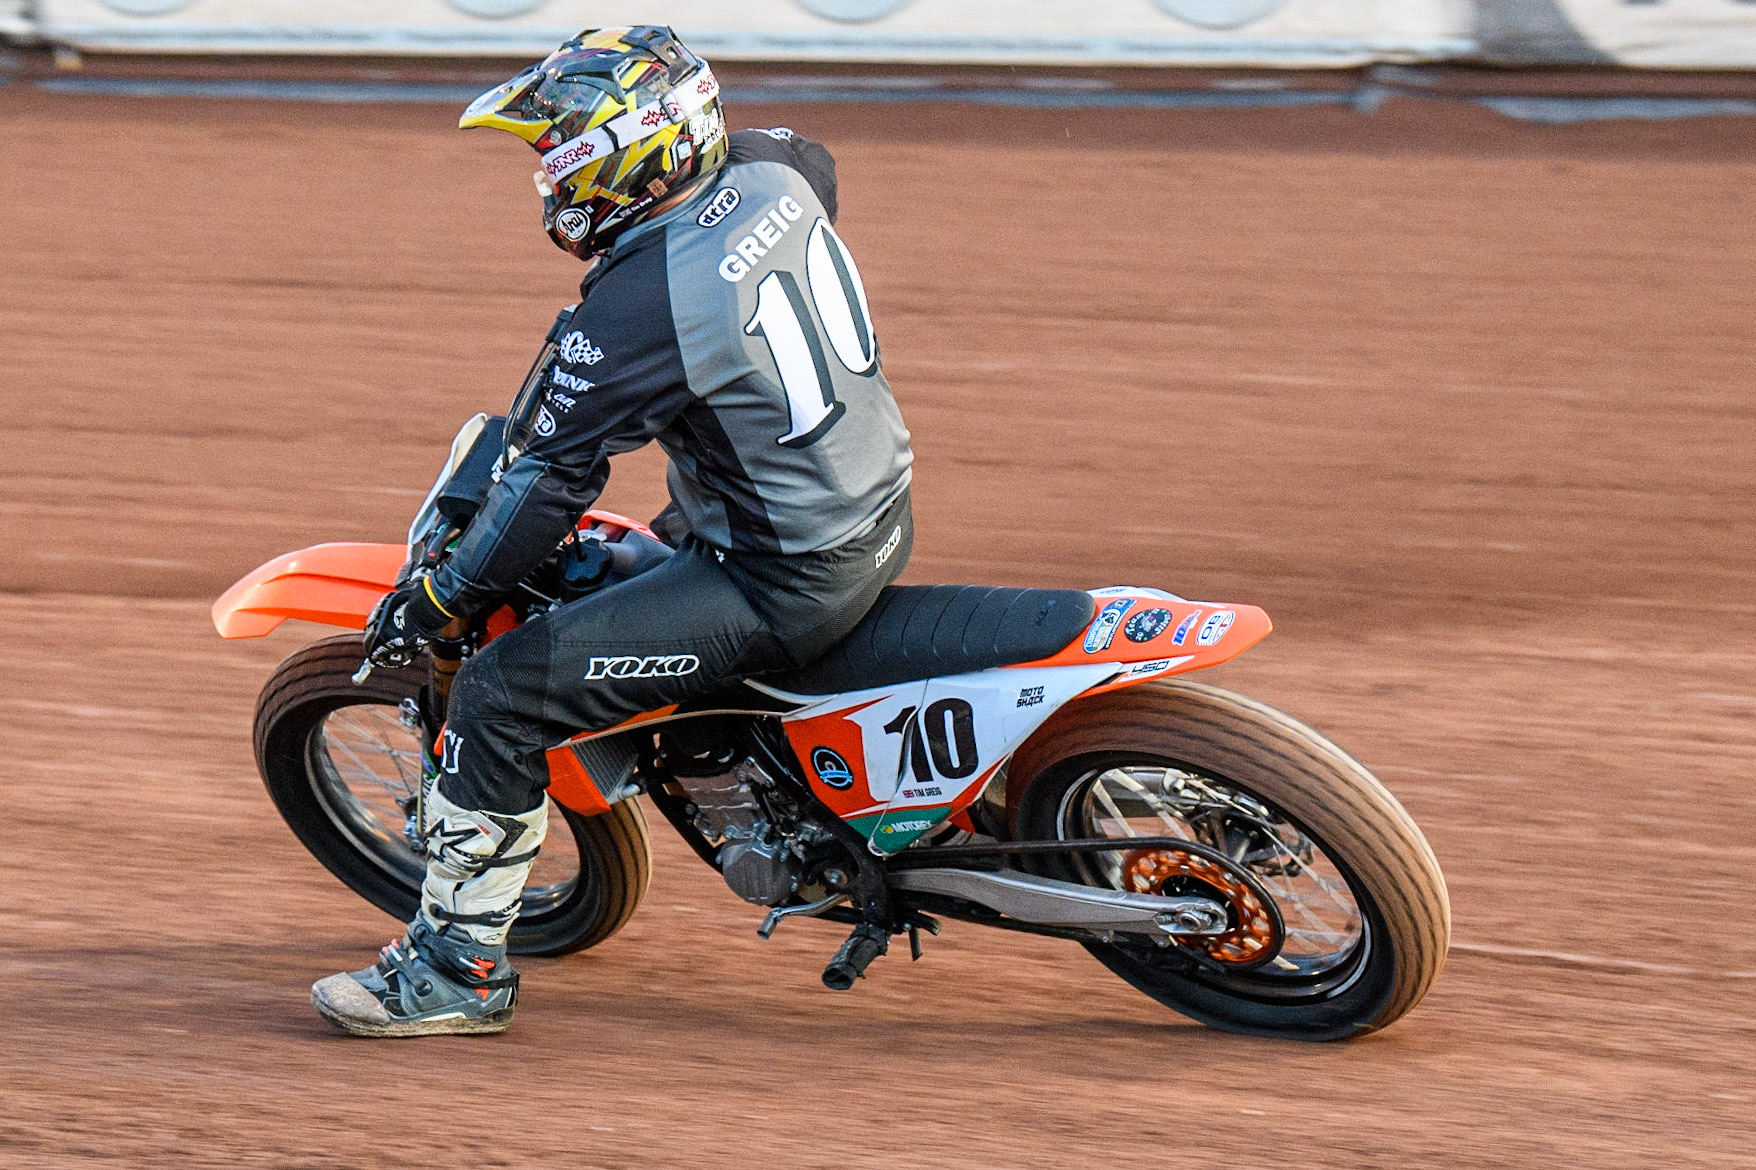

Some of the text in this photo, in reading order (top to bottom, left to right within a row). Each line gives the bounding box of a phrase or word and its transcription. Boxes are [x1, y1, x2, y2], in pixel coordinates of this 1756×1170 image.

[718, 195, 804, 282] GREIG
[744, 217, 877, 449] 10
[875, 524, 902, 569] YOKO
[584, 654, 699, 680] YOKO
[1016, 695, 1045, 708] SHACK
[1020, 685, 1044, 697] MOTO
[883, 698, 979, 783] 10
[913, 787, 942, 798] TIM GREIG
